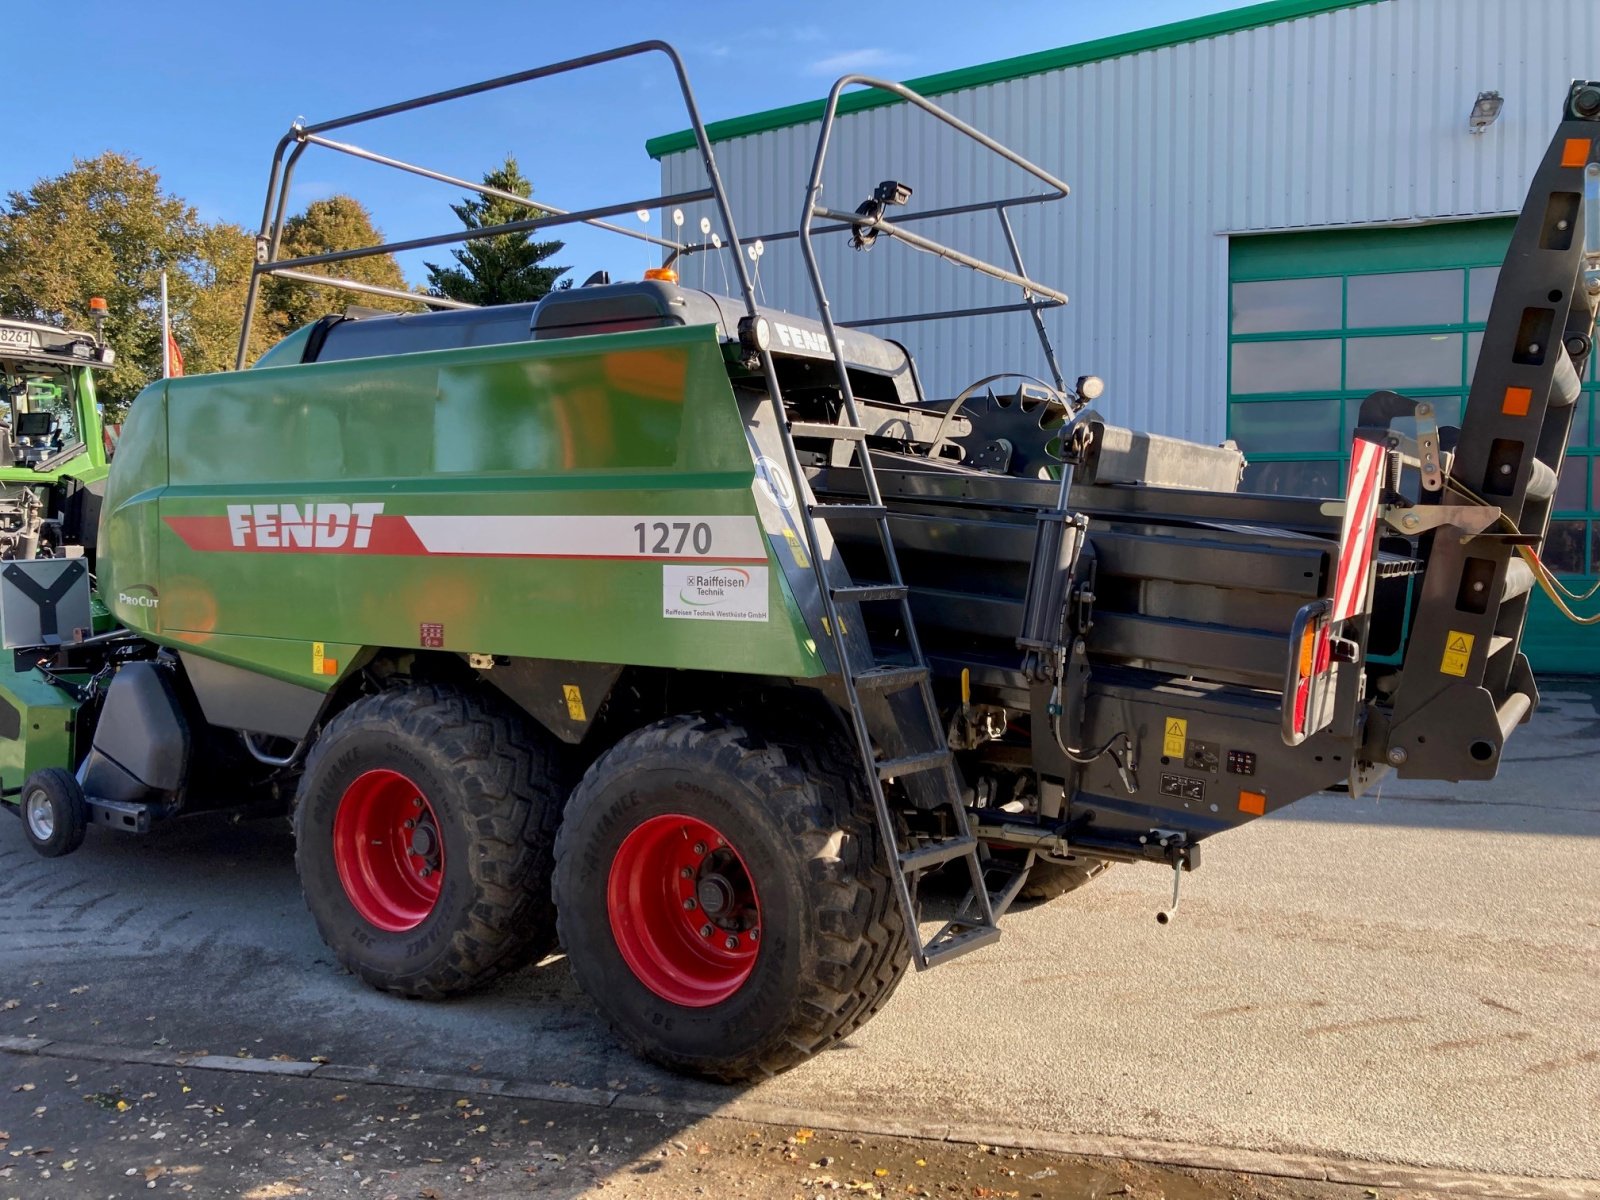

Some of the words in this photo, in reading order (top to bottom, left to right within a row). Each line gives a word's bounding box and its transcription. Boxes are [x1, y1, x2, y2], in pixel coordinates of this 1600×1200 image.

[1, 329, 29, 343] 8261
[227, 503, 384, 549] FENDT
[634, 522, 711, 554] 1270
[696, 576, 744, 588] Raiffeisen
[697, 588, 724, 597] Technik
[665, 608, 692, 616] Raiffeisen
[693, 609, 715, 617] Technik
[716, 610, 747, 619] Westküste
[748, 611, 767, 619] GmbH
[583, 789, 641, 871] ALLIANCE
